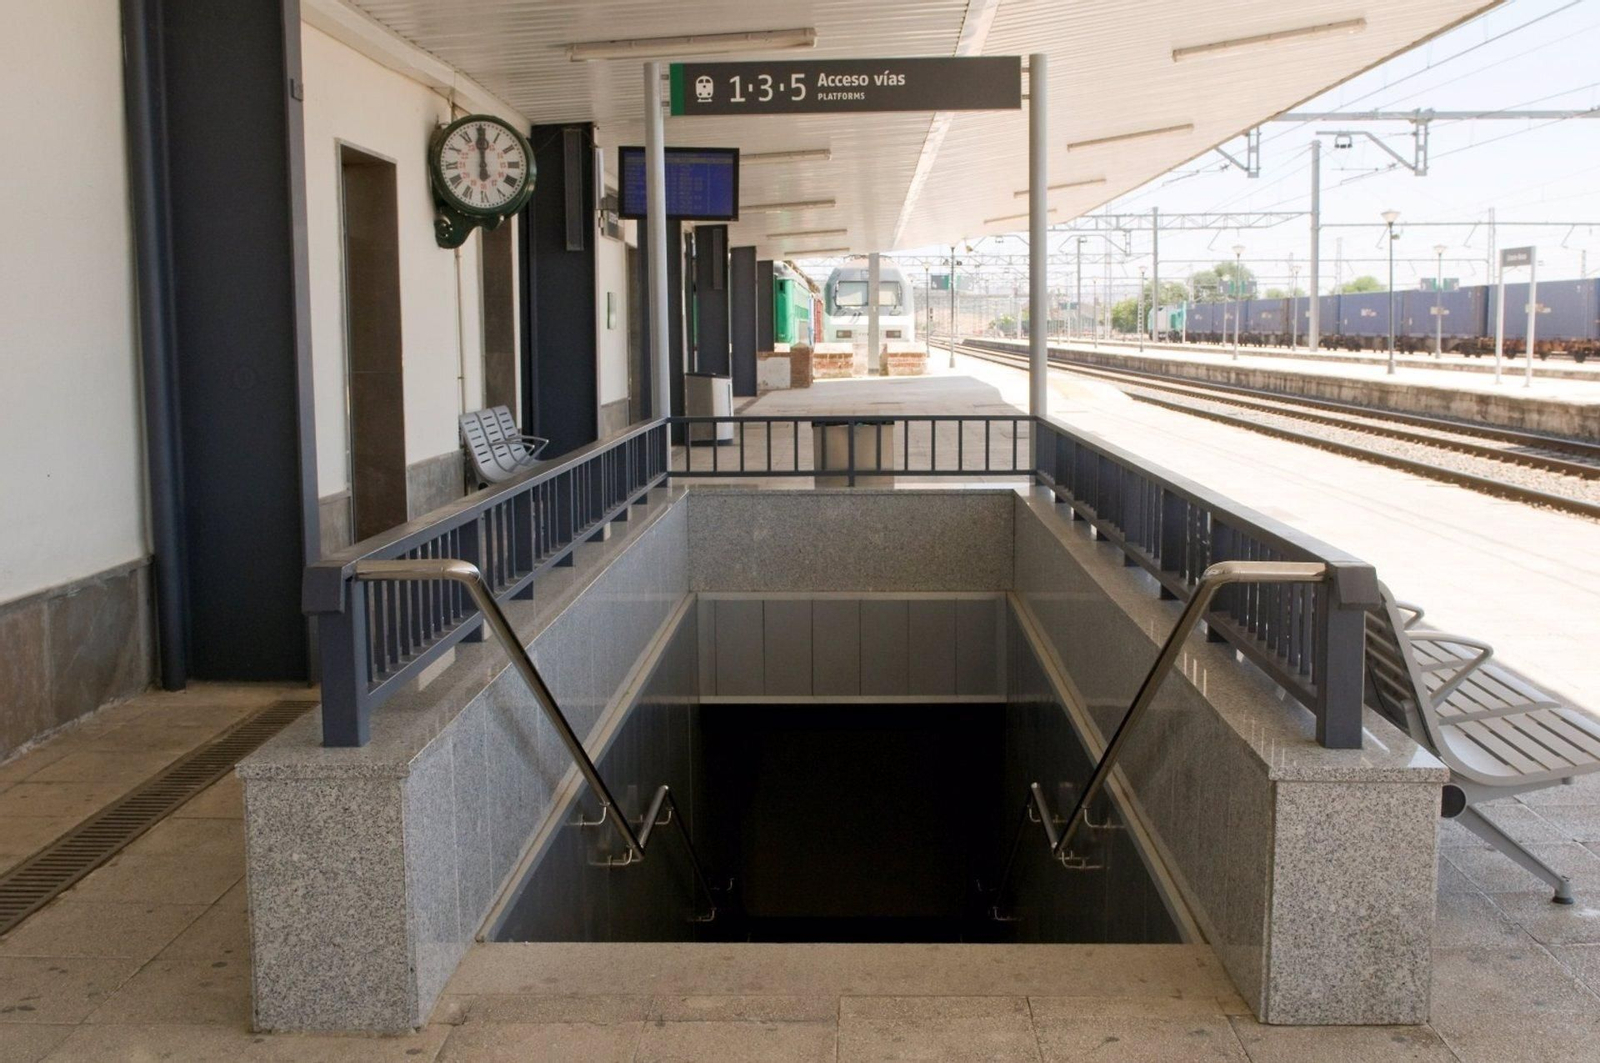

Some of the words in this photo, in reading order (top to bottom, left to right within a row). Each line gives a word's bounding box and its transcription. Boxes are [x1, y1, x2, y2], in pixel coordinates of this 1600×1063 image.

[817, 73, 869, 87] Acceso
[874, 70, 906, 86] vías
[817, 92, 865, 101] PLATFORMS
